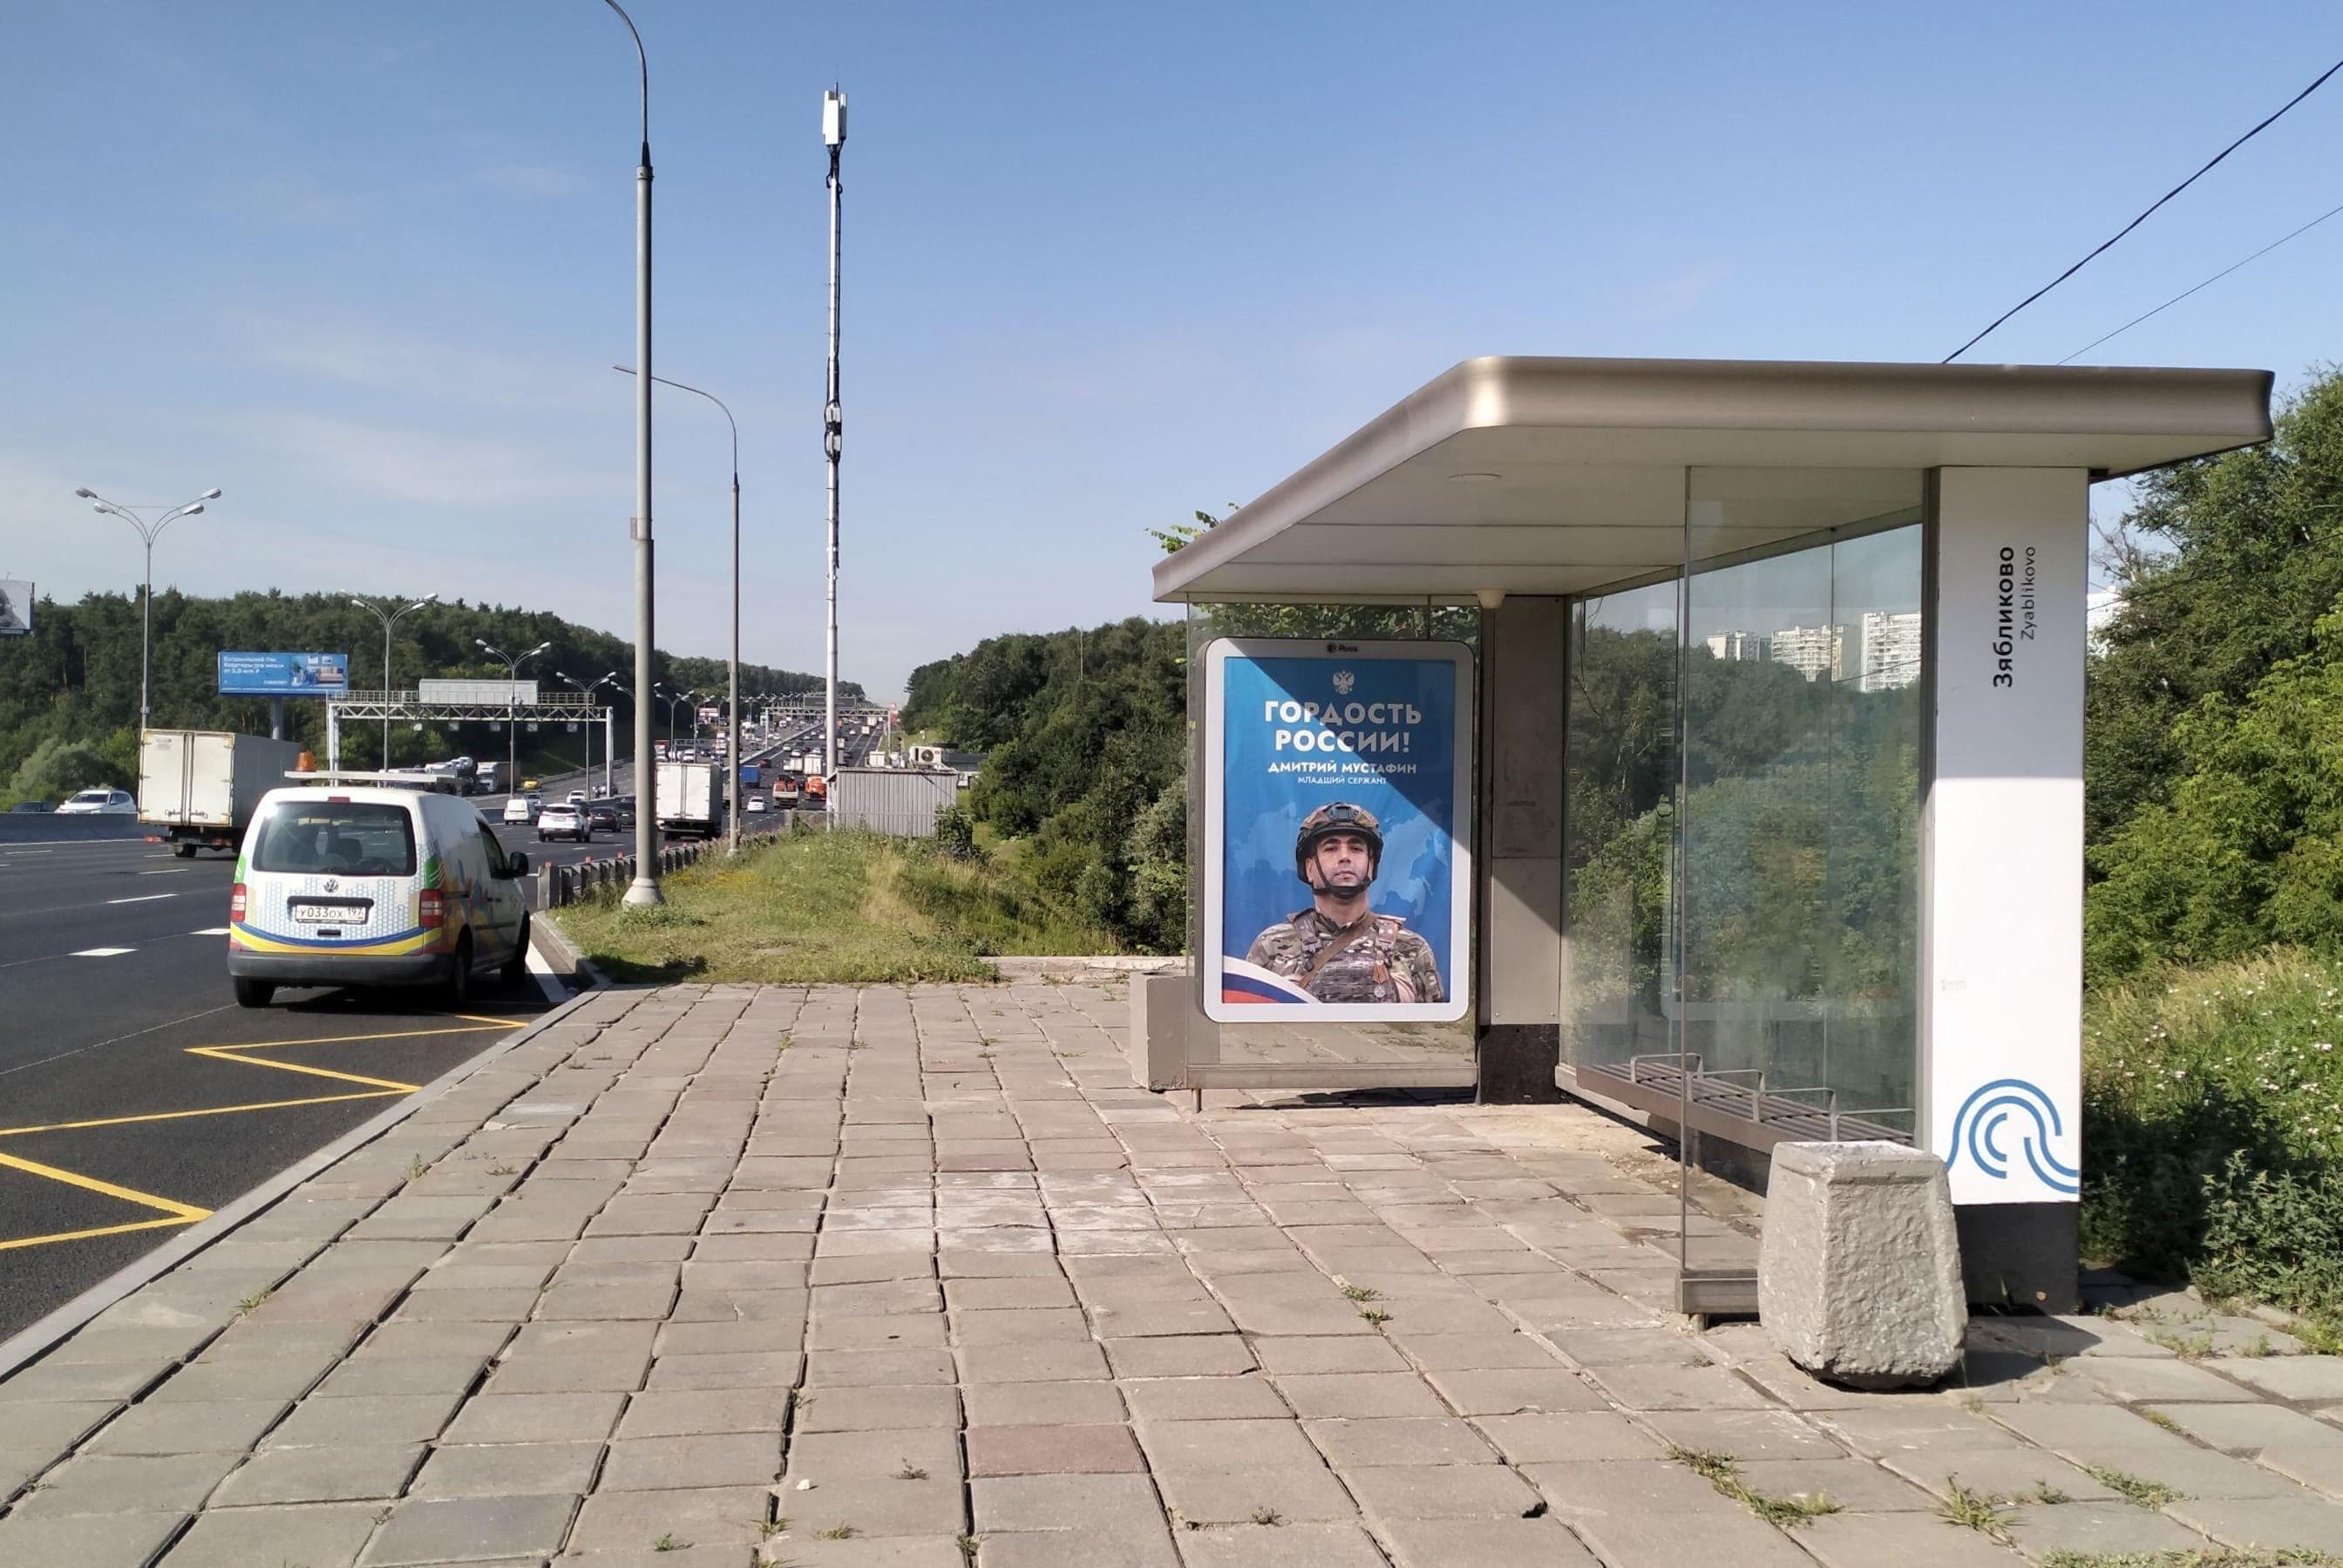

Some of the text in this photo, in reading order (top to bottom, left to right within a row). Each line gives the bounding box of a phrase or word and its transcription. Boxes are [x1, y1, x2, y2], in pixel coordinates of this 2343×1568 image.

[2020, 546, 2037, 641] Zyablikovo
[1993, 546, 2014, 688] Зябликово
[1265, 700, 1422, 726] ГОРДОСТЬ
[1274, 729, 1410, 753] РОССИИ!
[1267, 759, 1417, 774] ДМИТРИЙ МУСТАФИН
[1297, 775, 1387, 785] МЛАДШИЙ СЕРЖАНТ
